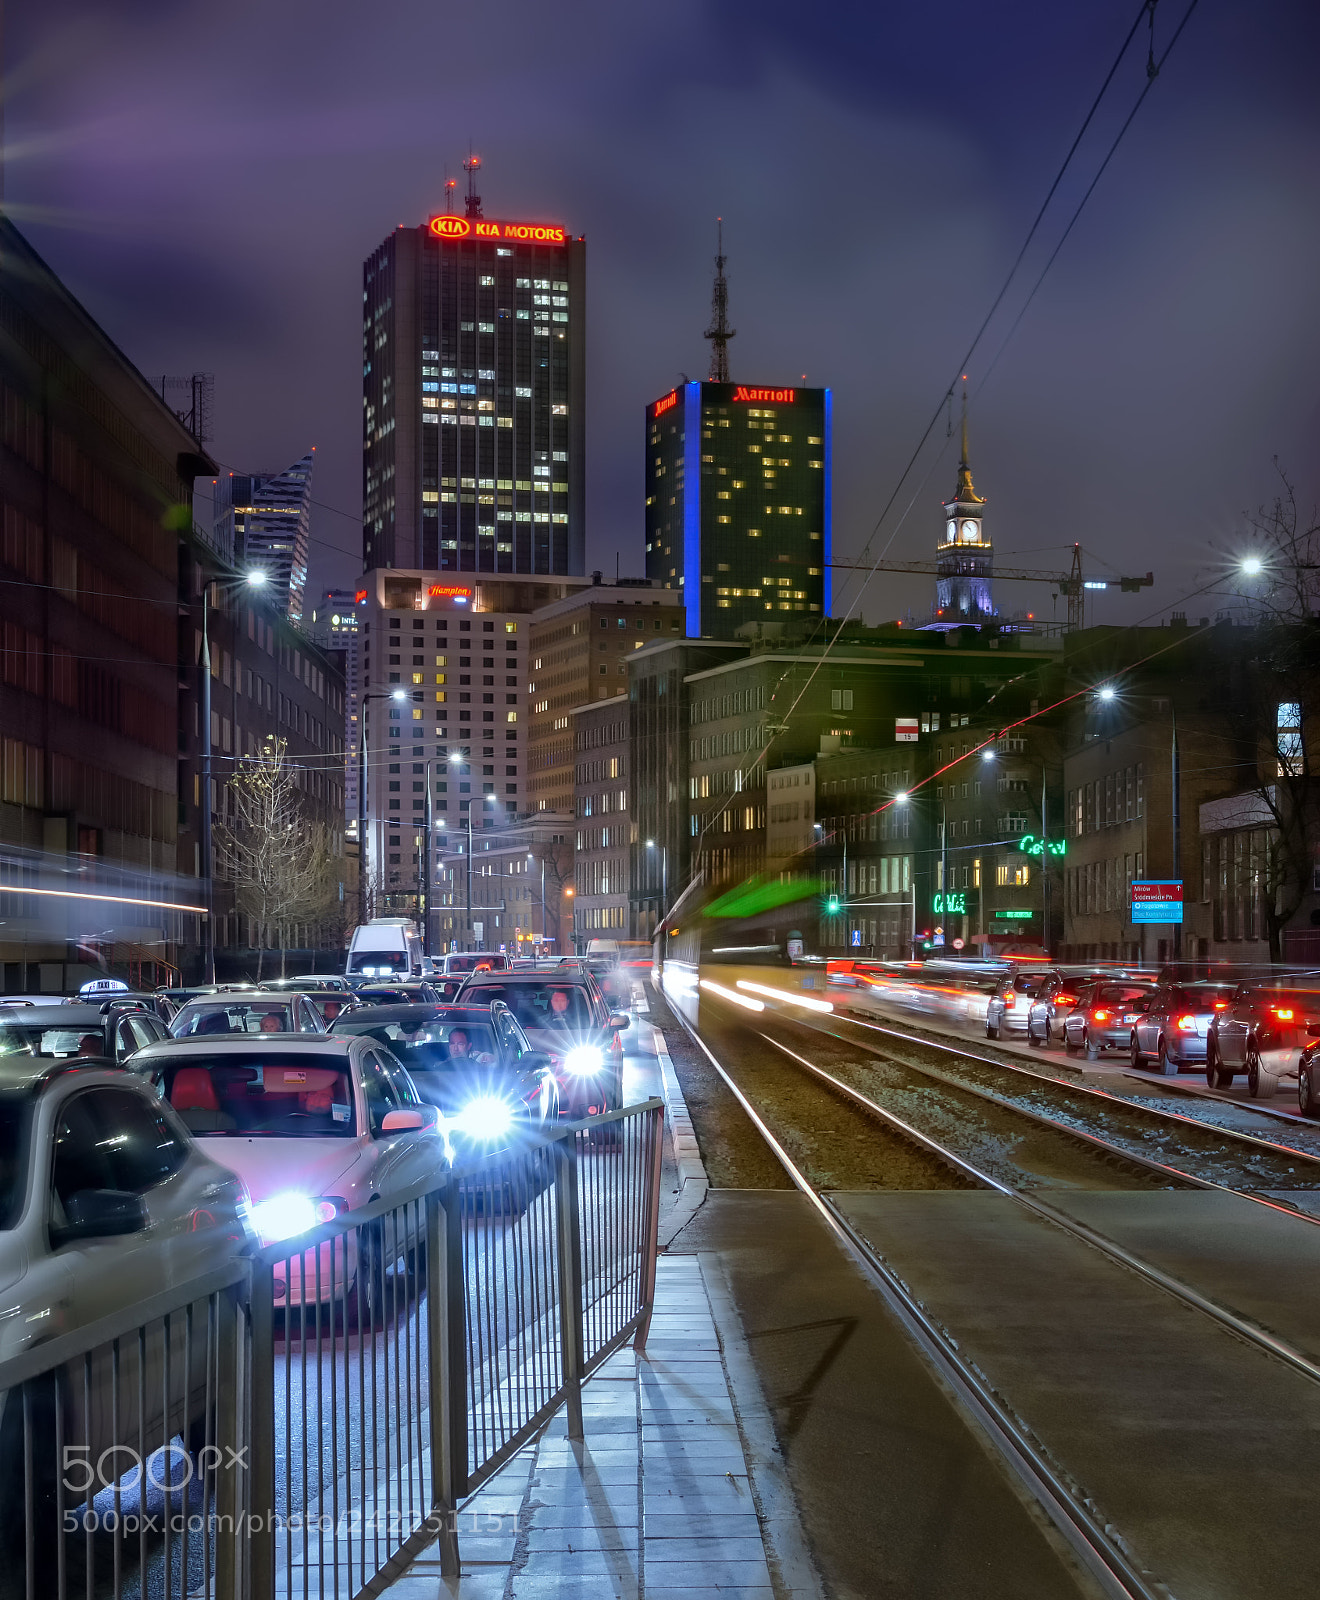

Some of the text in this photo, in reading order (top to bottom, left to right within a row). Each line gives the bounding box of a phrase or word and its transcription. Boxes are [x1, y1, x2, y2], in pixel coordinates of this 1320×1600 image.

[437, 220, 463, 234] KIA
[476, 223, 563, 241] KIA MOTORS
[733, 386, 794, 402] Marriott
[428, 585, 471, 597] Hampton
